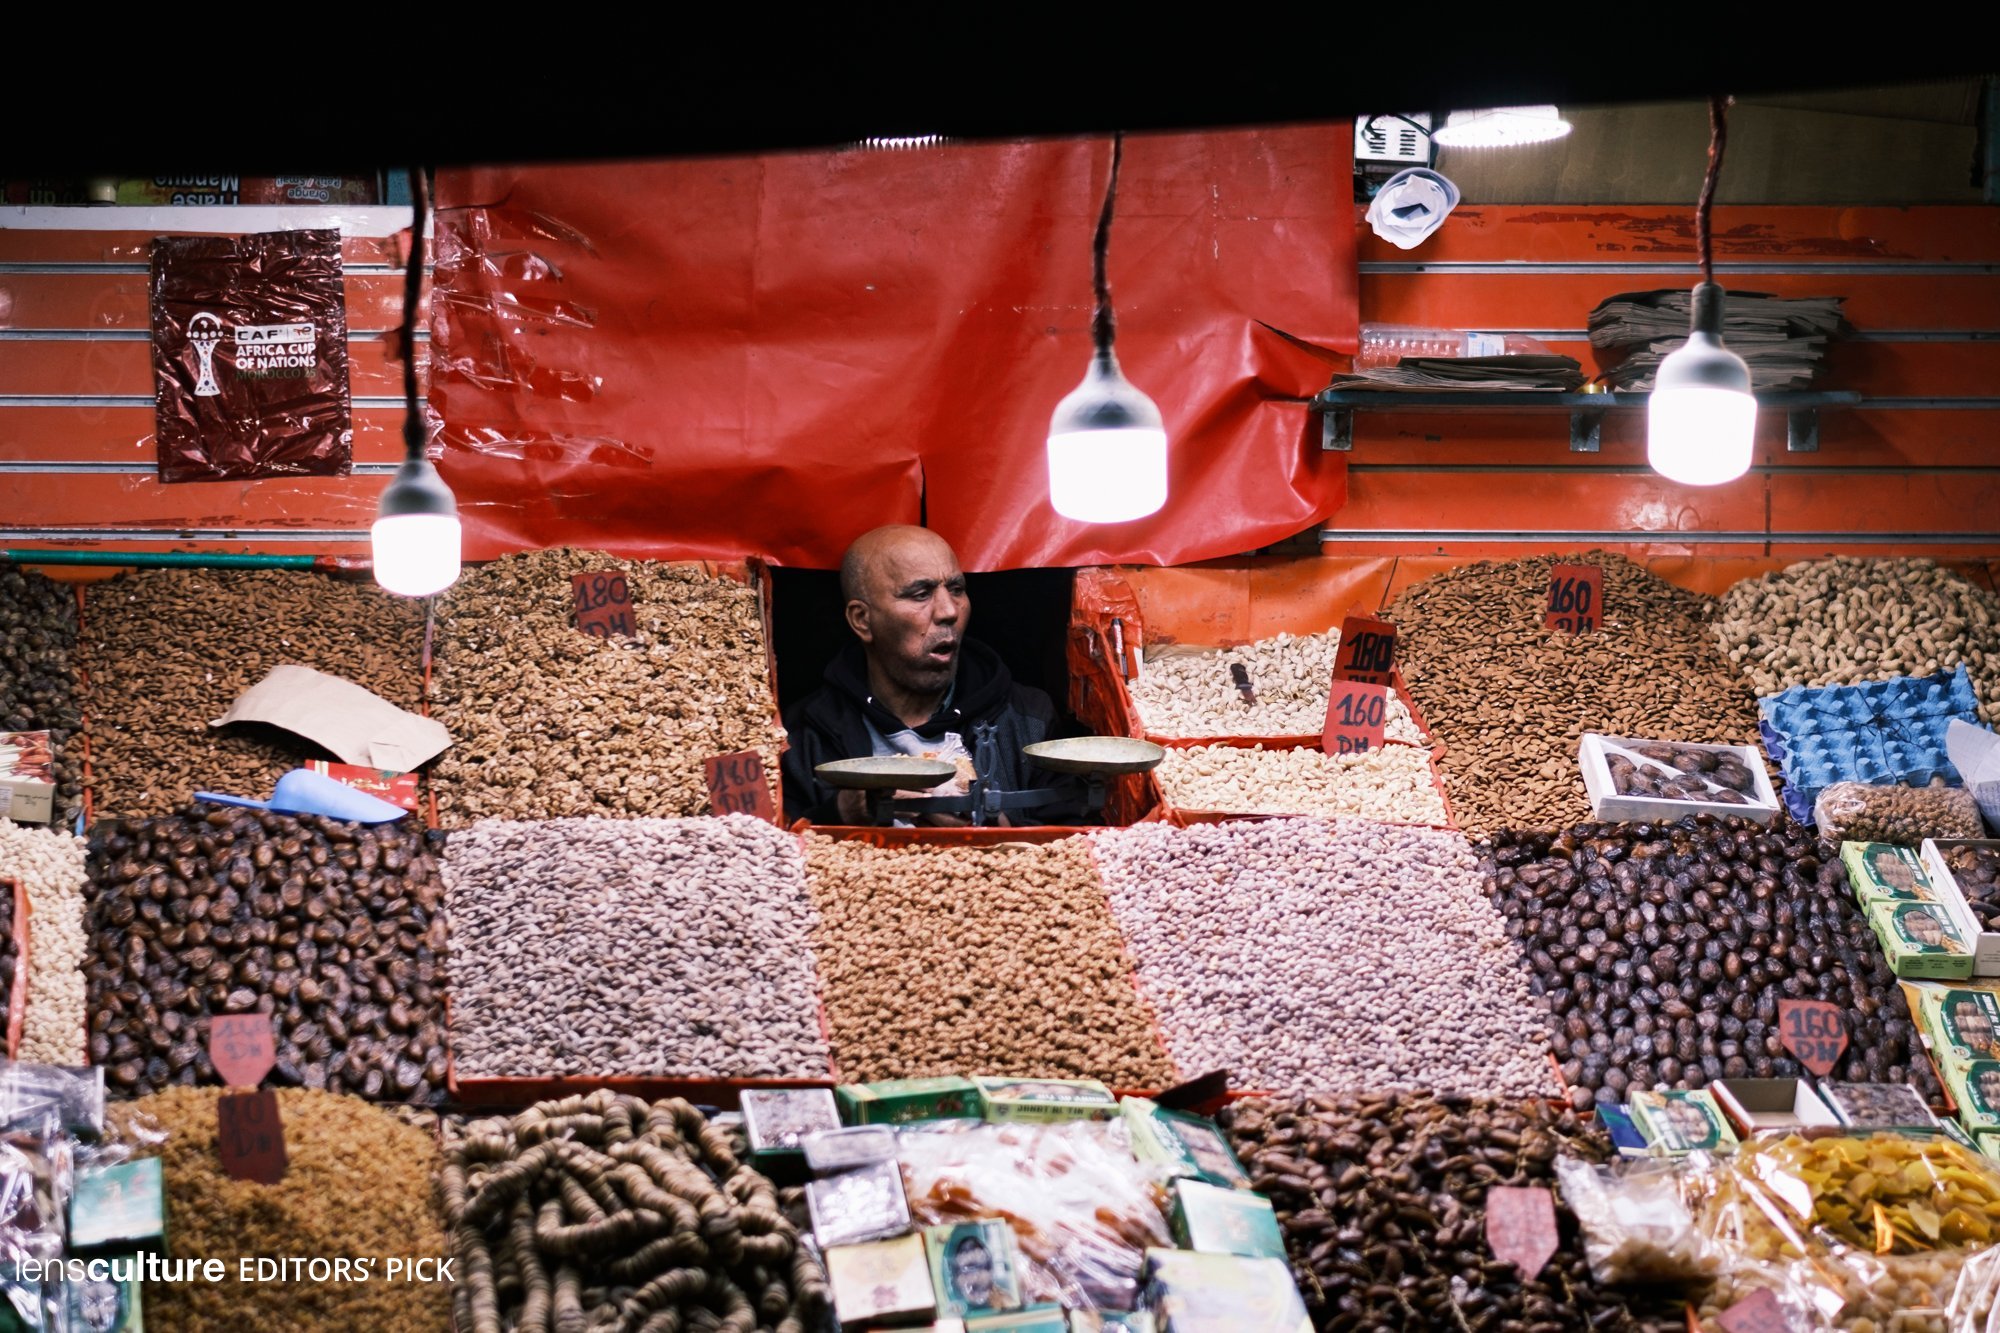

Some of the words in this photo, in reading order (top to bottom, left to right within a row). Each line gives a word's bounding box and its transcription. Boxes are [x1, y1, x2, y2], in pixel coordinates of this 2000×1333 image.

[288, 187, 328, 201] Orange
[237, 329, 278, 341] CAF
[236, 344, 286, 357] AFRICA
[288, 342, 316, 355] CUP
[235, 357, 255, 370] OF
[257, 355, 317, 369] NATIONS
[236, 368, 301, 380] MOROCCO
[576, 575, 629, 612] 180
[1548, 576, 1592, 615] 160
[1344, 631, 1394, 672] 180
[1336, 692, 1386, 727] 160
[1336, 734, 1369, 755] DH
[710, 757, 760, 793] 160
[717, 790, 757, 815] DH
[1785, 1006, 1844, 1038] 160
[1795, 1040, 1839, 1062] DH
